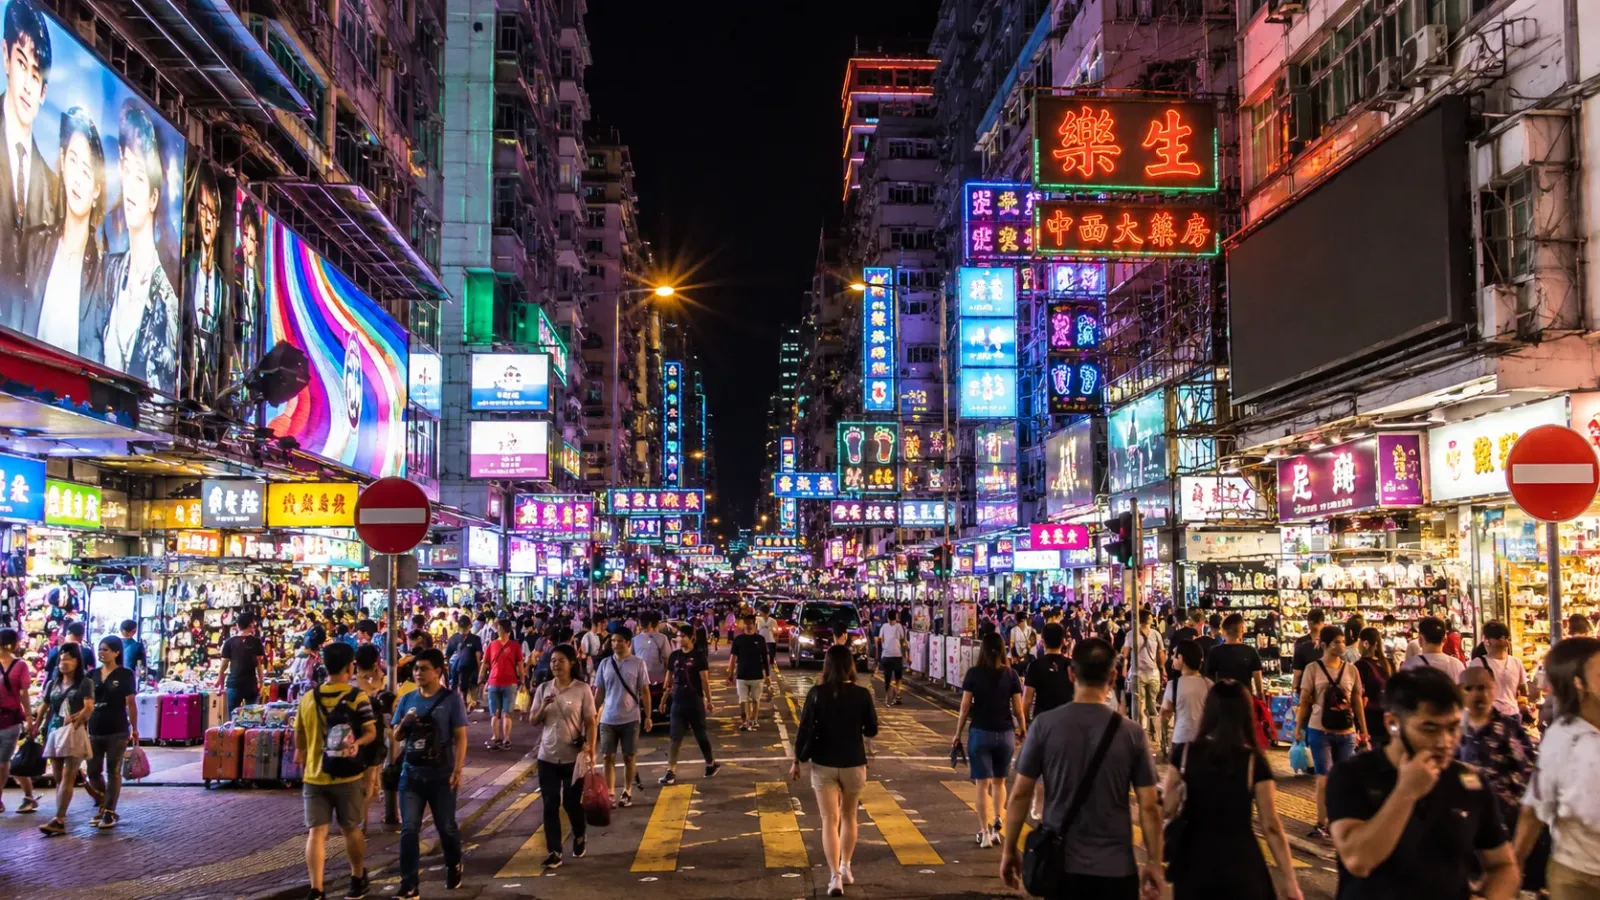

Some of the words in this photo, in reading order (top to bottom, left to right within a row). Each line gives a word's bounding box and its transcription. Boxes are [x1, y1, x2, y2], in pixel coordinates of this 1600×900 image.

[1053, 106, 1201, 176] 樂生
[1047, 210, 1211, 247] 中西大藥房
